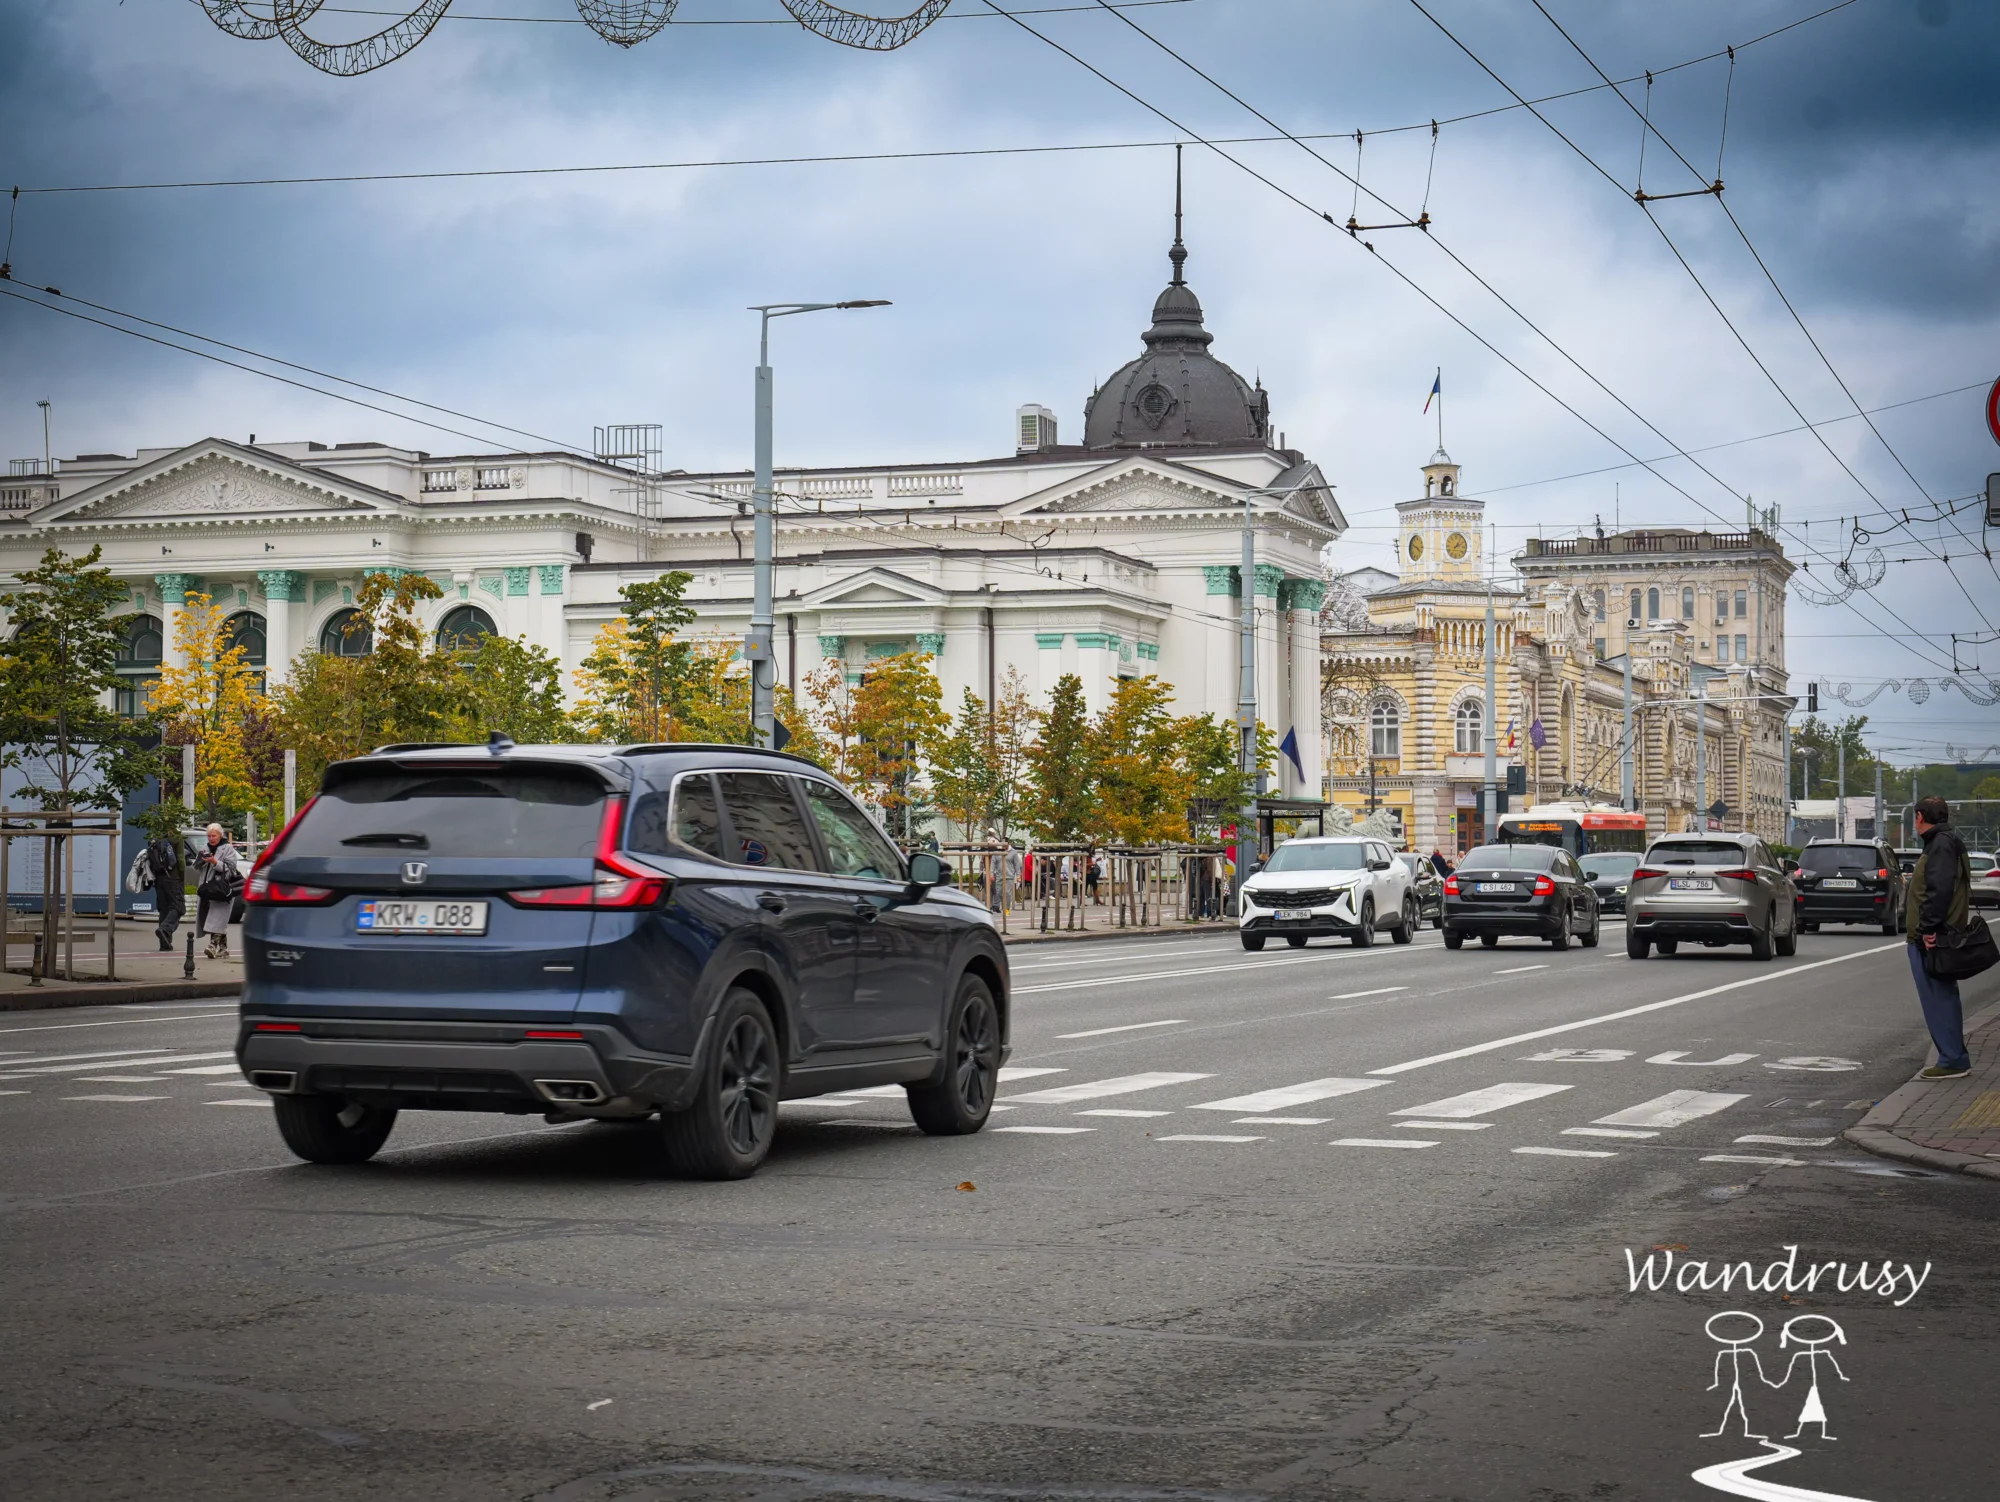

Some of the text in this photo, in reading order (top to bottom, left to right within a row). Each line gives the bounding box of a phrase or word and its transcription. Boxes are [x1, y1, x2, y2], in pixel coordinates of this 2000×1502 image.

[1696, 880, 1709, 888] 786
[375, 903, 473, 927] KRW 088
